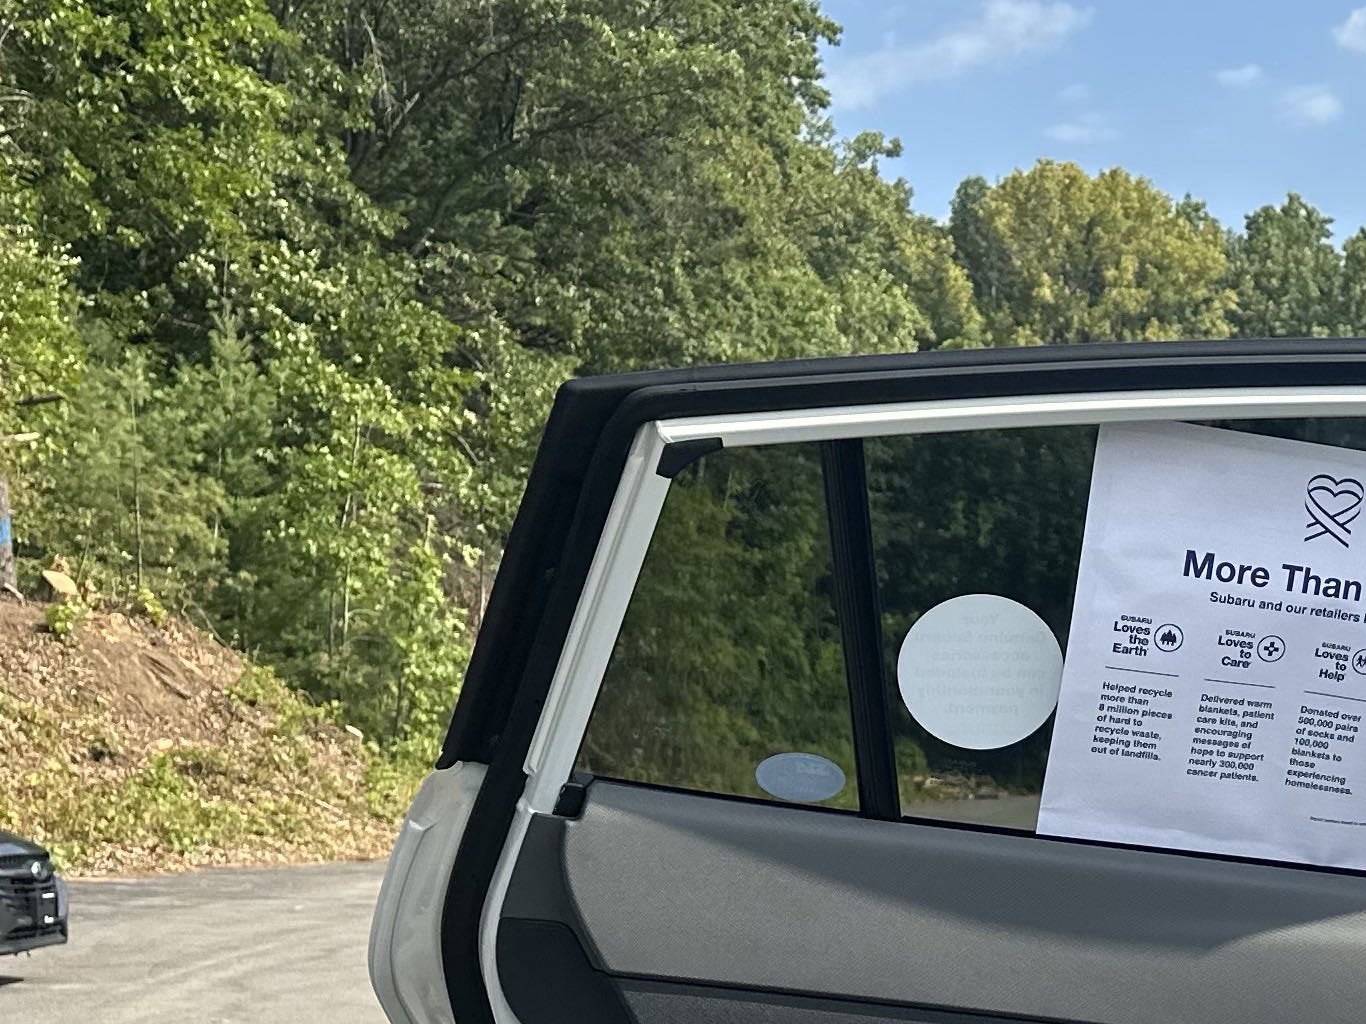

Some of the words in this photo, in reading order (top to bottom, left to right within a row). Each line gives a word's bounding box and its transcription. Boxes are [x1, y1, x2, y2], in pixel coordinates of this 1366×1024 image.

[1182, 549, 1269, 587] More
[1281, 563, 1361, 601] Than
[1209, 591, 1255, 607] Subaru
[1258, 600, 1282, 611] and
[1285, 604, 1307, 614] our
[1309, 607, 1360, 622] retailers
[1113, 620, 1150, 635] Loves
[1128, 634, 1149, 645] the
[1217, 635, 1253, 649] Loves
[1112, 642, 1147, 656] Earth
[1239, 648, 1251, 659] to
[1314, 647, 1348, 661] Loves
[1221, 656, 1250, 668] Care
[1335, 661, 1346, 671] to
[1318, 668, 1345, 682] Help
[1102, 681, 1136, 693] Helped
[1137, 687, 1172, 697] recycle
[1100, 694, 1125, 703] more
[1127, 695, 1149, 706] than
[1200, 693, 1245, 705] Delivered
[1246, 700, 1272, 709] warm
[1106, 704, 1139, 715] million
[1140, 708, 1172, 719] pieces
[1198, 704, 1240, 717] blankets,
[1241, 710, 1274, 720] patient
[1300, 705, 1339, 718] Donated
[1340, 713, 1361, 722] over
[1108, 714, 1131, 725] hard
[1218, 716, 1238, 728] kits,
[1094, 725, 1129, 735] recycle
[1131, 729, 1161, 740] waste,
[1194, 727, 1252, 740] encouraging
[1307, 729, 1334, 739] socks
[1334, 723, 1358, 732] pairs
[1092, 734, 1130, 747] keeping
[1133, 739, 1156, 749] them
[1192, 737, 1239, 748] messages
[1294, 737, 1329, 749] 100,000
[1120, 748, 1160, 760] landfills.
[1190, 746, 1214, 757] hope
[1215, 748, 1225, 757] to
[1227, 751, 1264, 761] support
[1291, 746, 1330, 760] blankets
[1332, 753, 1342, 762] to
[1188, 758, 1217, 768] nearly
[1289, 757, 1315, 768] those
[1186, 768, 1218, 777] cancer
[1219, 771, 1258, 781] patients.
[1286, 769, 1345, 785] experiencing
[1284, 777, 1352, 794] homelessness.
